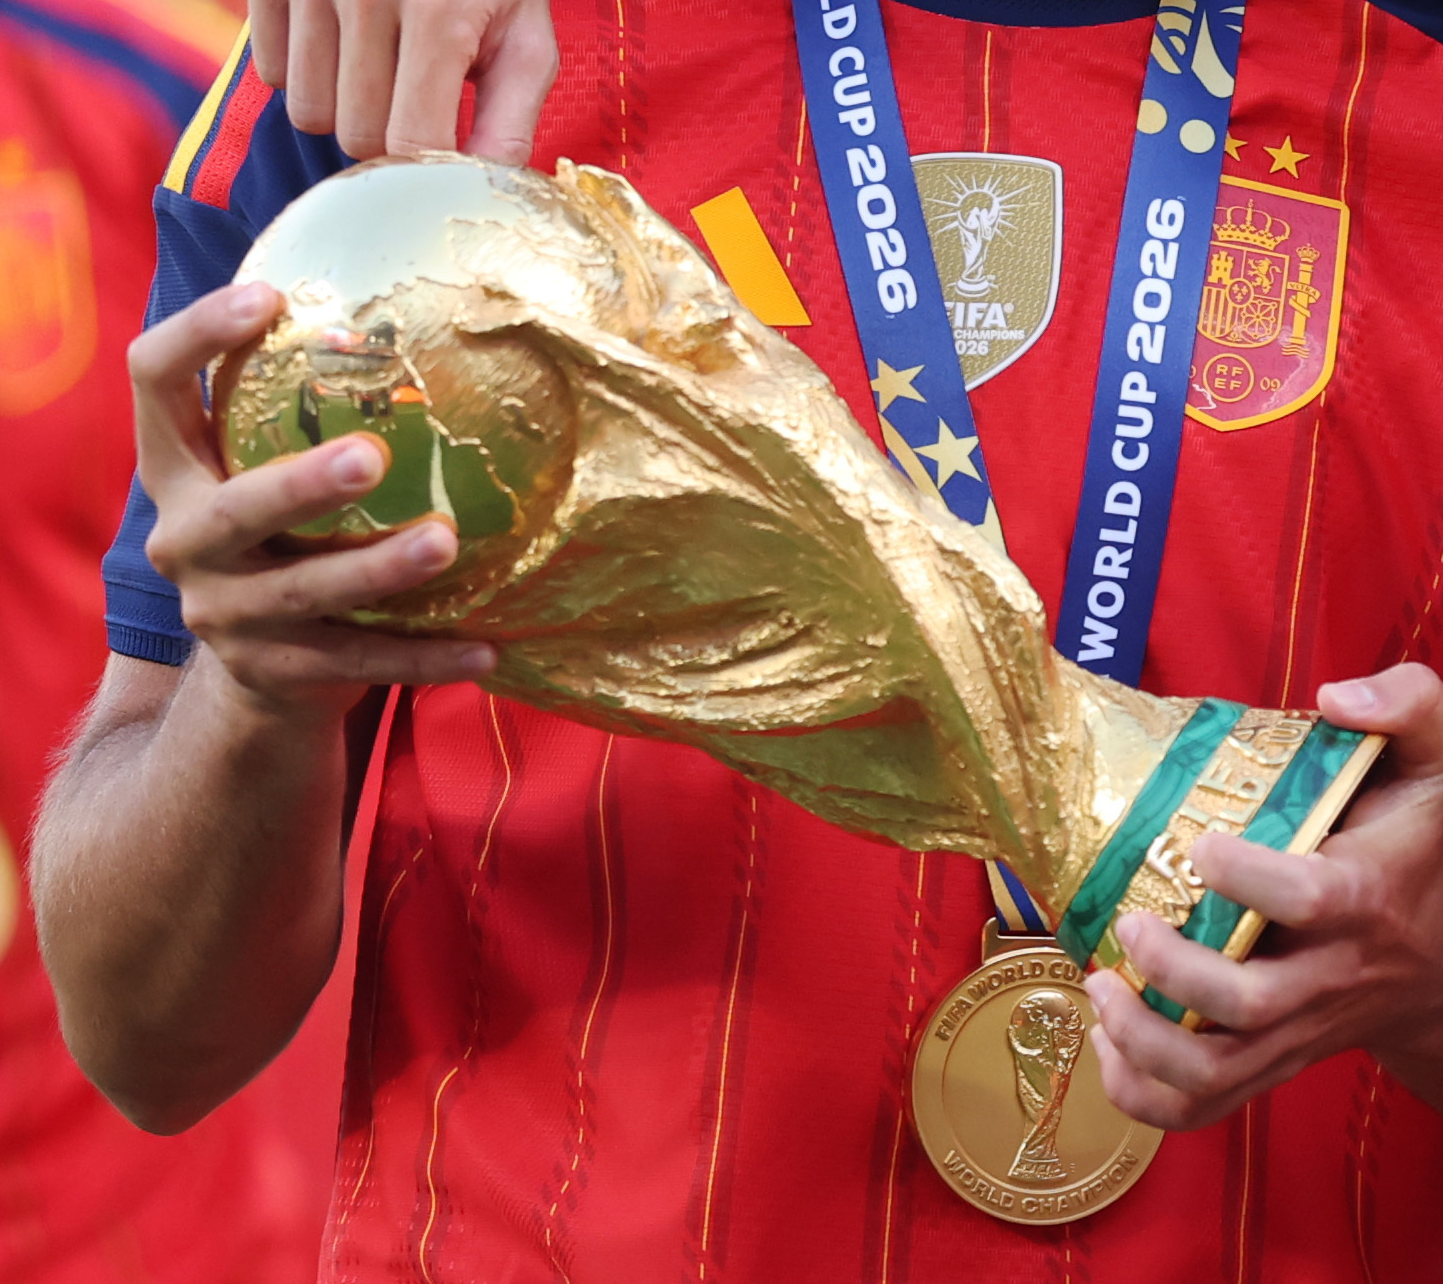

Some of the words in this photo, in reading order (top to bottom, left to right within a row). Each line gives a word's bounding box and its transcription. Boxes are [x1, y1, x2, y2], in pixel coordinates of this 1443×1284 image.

[829, 46, 877, 137] CUP
[846, 144, 918, 314] 2026
[1126, 197, 1186, 365] 2026
[954, 329, 1025, 340] CHAMPIONS
[955, 340, 989, 355] 026
[1112, 370, 1157, 472] CUP
[1259, 376, 1281, 392] 09
[1077, 480, 1143, 662] WORLD
[1255, 718, 1313, 767] CU
[1146, 725, 1268, 879] FIFA
[934, 996, 974, 1041] FIFA
[967, 959, 1045, 1001] WORLD
[1049, 959, 1085, 984] CU
[943, 1149, 1016, 1211] WORLD
[1021, 1148, 1139, 1214] CHAMPION
